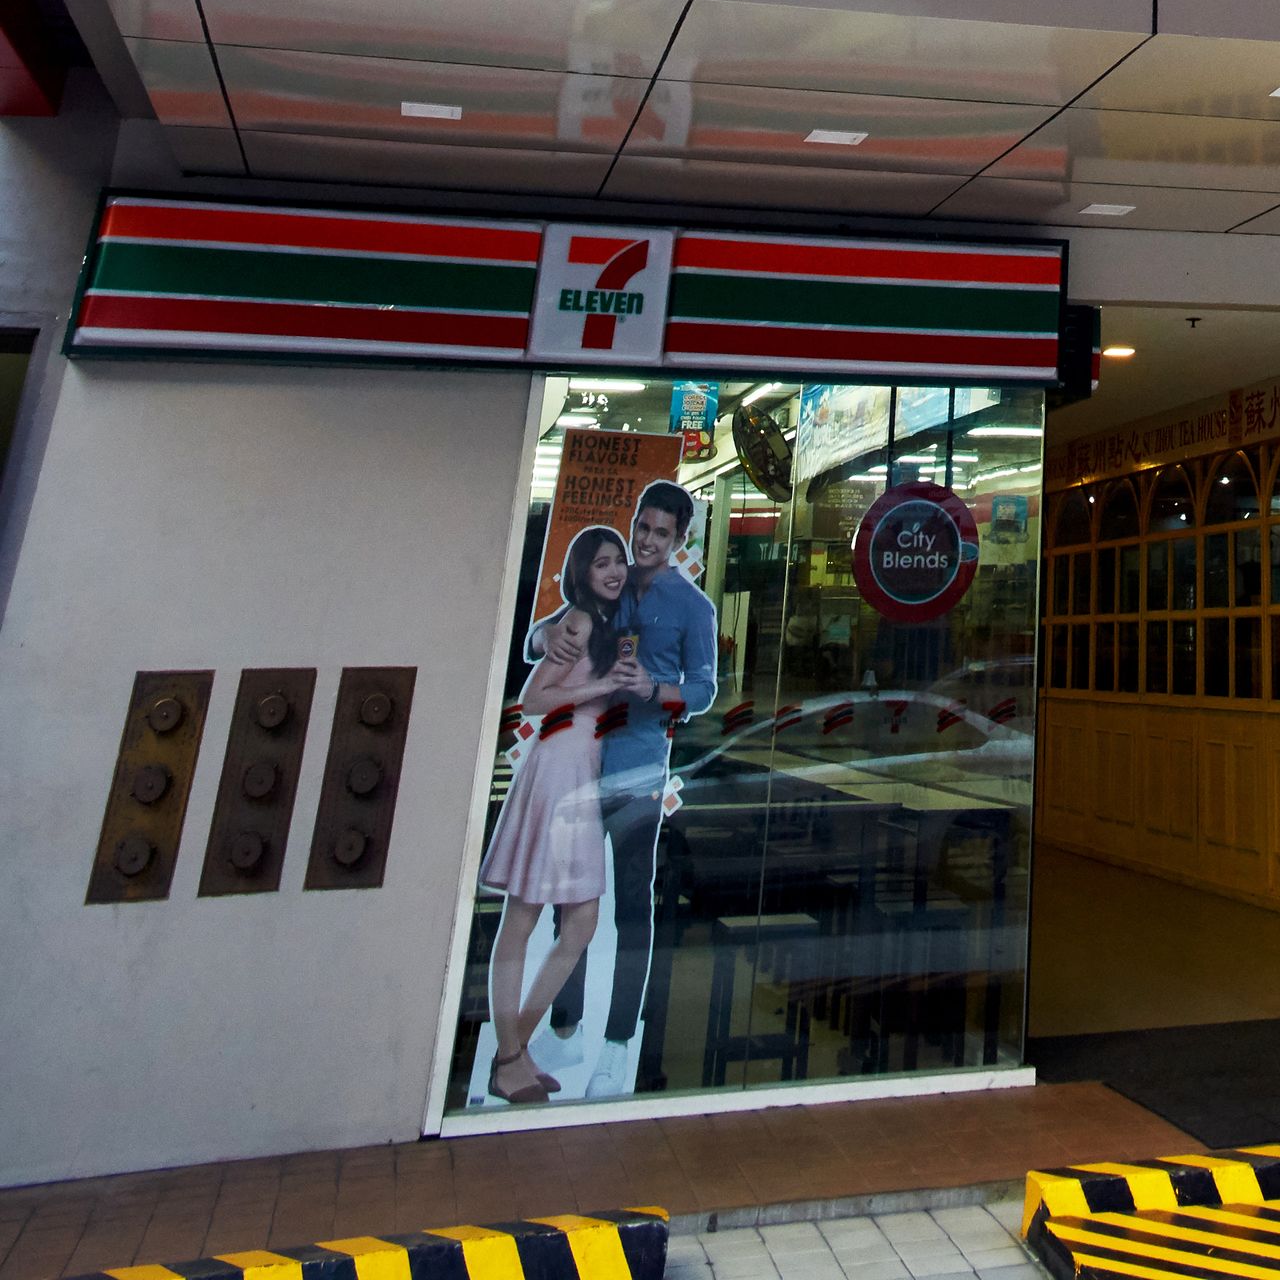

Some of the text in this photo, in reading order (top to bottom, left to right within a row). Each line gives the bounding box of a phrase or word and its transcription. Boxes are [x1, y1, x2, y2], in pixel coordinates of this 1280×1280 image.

[567, 235, 650, 351] 7
[681, 420, 704, 430] FREE
[1179, 419, 1197, 448] TEA
[1197, 408, 1228, 442] HOUSE
[571, 434, 642, 453] HONEST
[569, 449, 638, 467] FLAVORS
[565, 475, 636, 494] HONEST
[561, 490, 633, 508] FEELINGS
[896, 524, 936, 551] City
[882, 551, 949, 570] Blends
